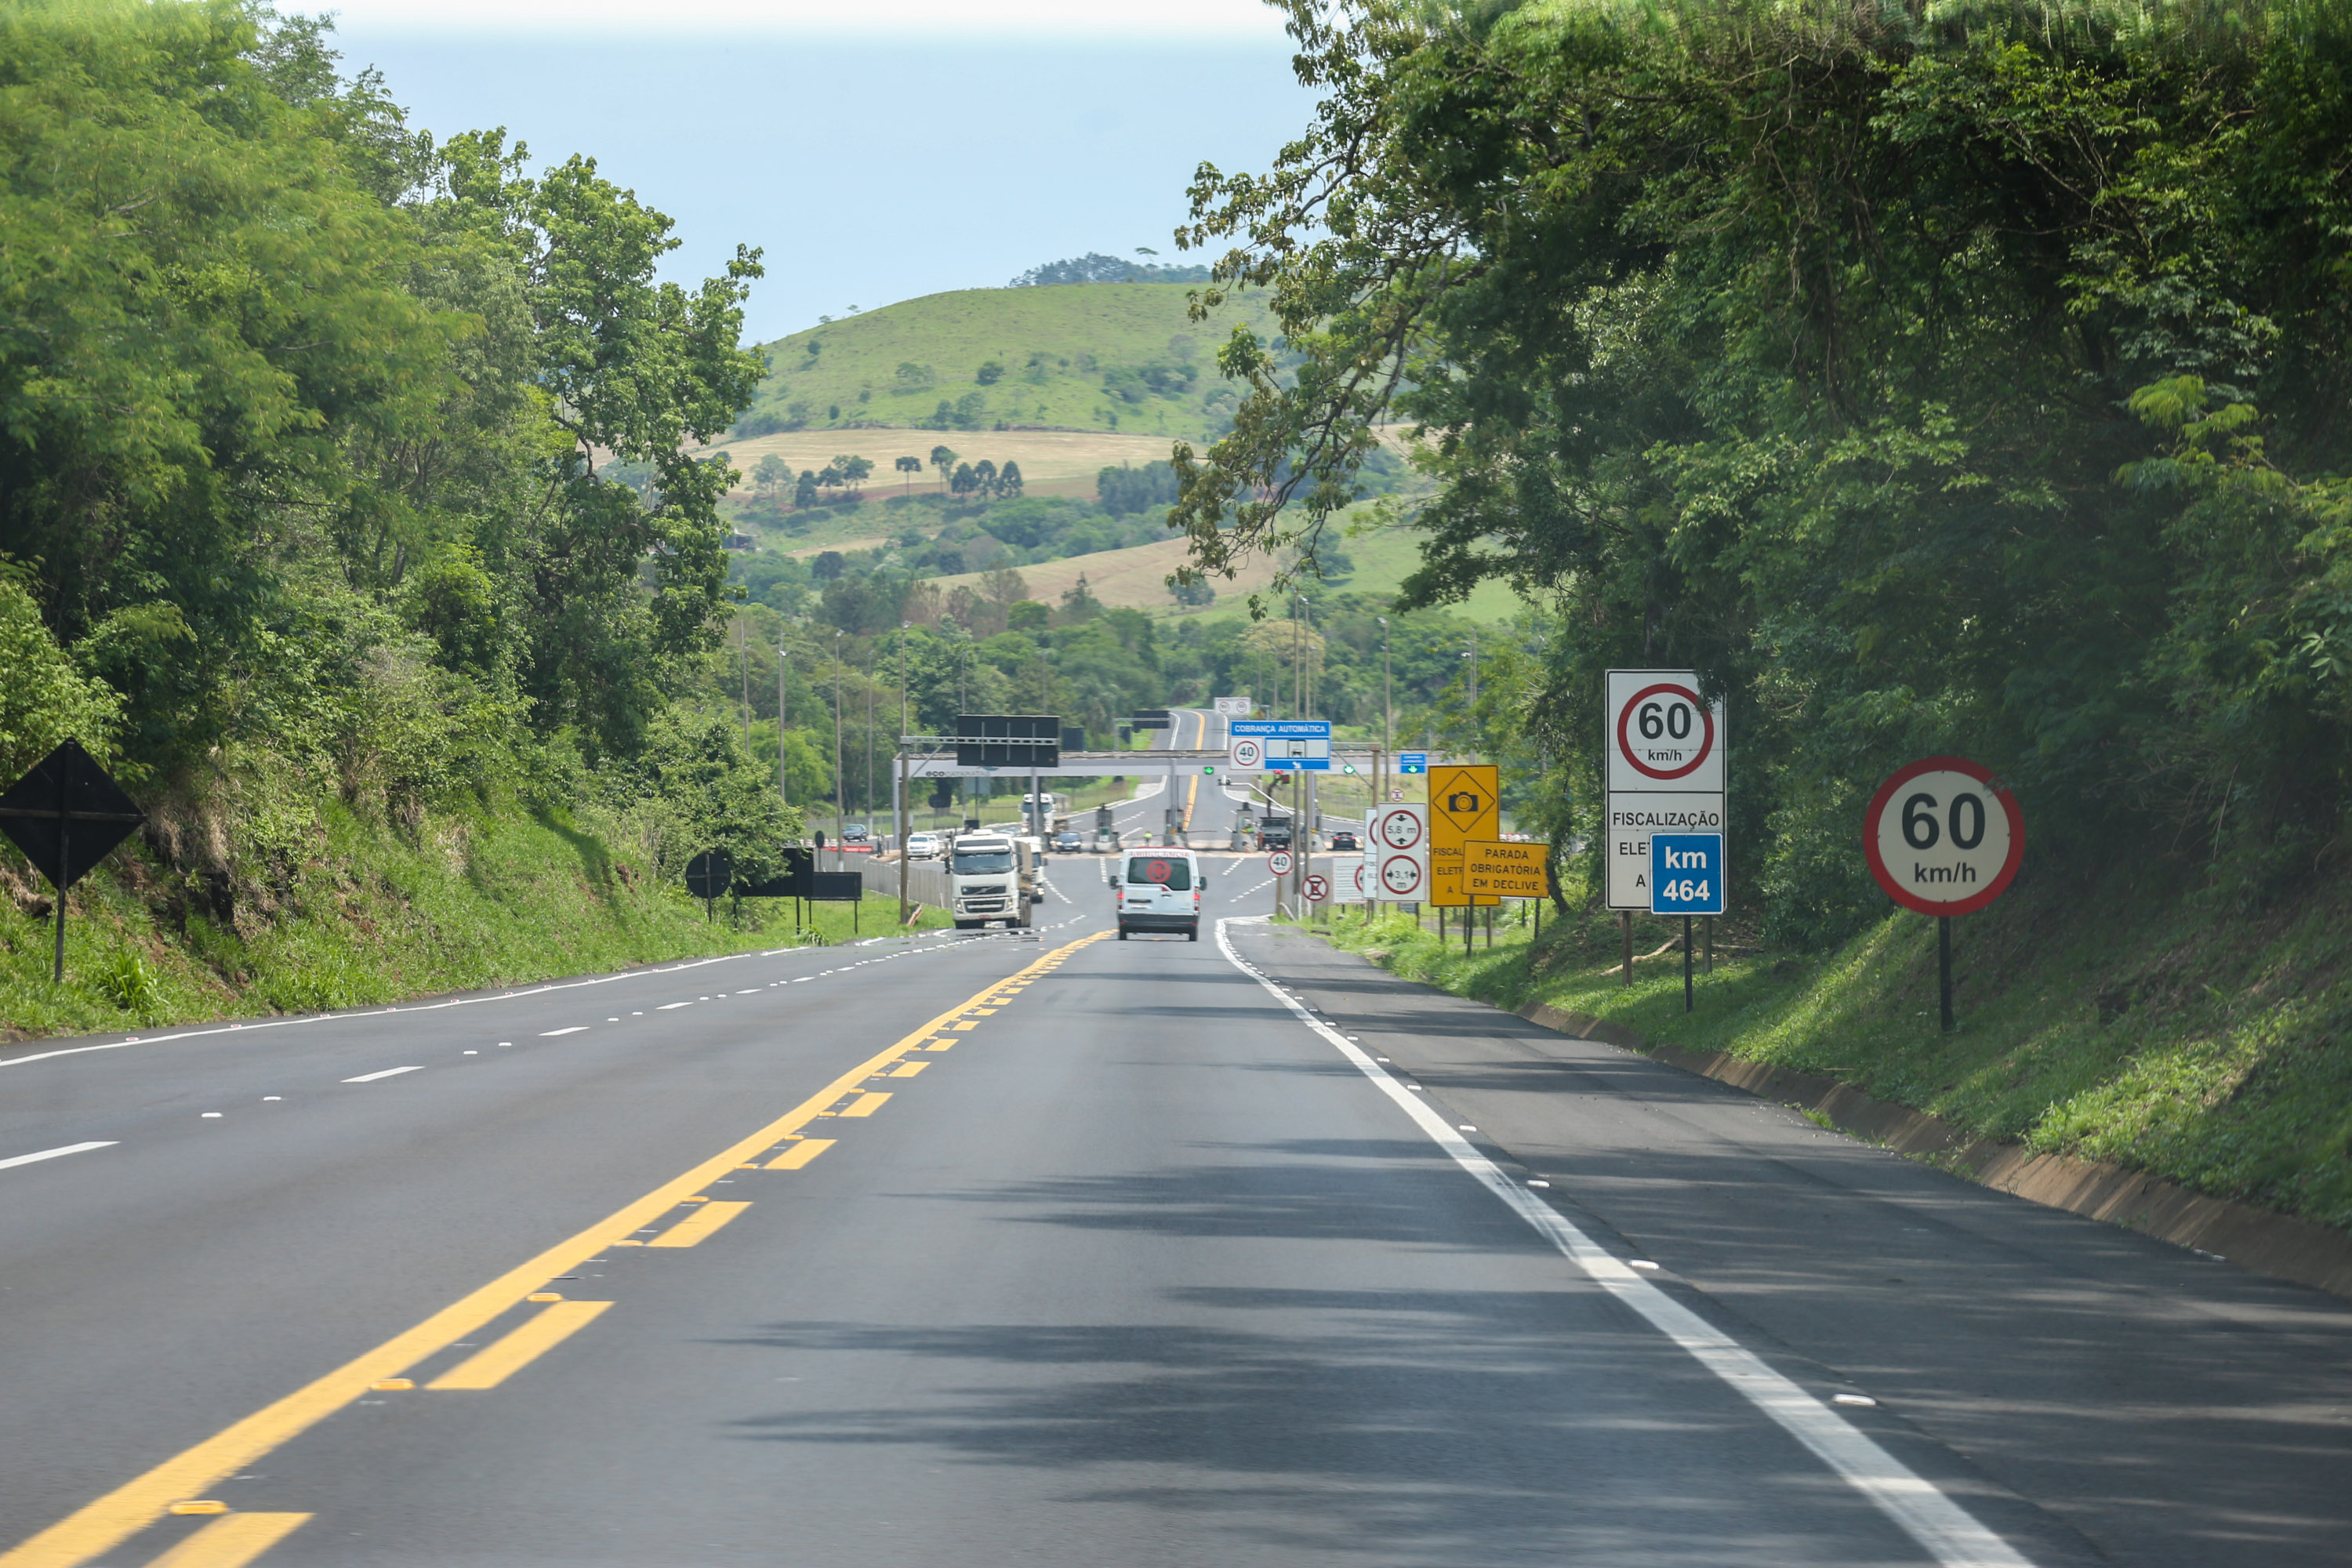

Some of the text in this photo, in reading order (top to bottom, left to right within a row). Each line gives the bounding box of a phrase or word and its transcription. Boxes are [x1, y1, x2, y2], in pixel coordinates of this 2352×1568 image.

[1639, 702, 1691, 739] 60
[1235, 724, 1326, 734] COBRANÇA AUTOMÁTICA
[1240, 747, 1254, 757] 40
[1648, 749, 1682, 761] km/h
[1613, 811, 1719, 829] FISCALIZAÇÃO
[1902, 793, 1986, 850] 60
[1387, 826, 1403, 834] 5,8
[1485, 849, 1529, 859] PARADA
[1665, 846, 1707, 869] km
[1273, 856, 1287, 866] 40
[1394, 870, 1410, 879] 3,1
[1471, 862, 1541, 876] OBRIGATÓRIA
[1915, 862, 1976, 883] km/h
[1472, 878, 1539, 891] EM DECLIVE
[1635, 874, 1646, 887] A
[1663, 880, 1711, 902] 464
